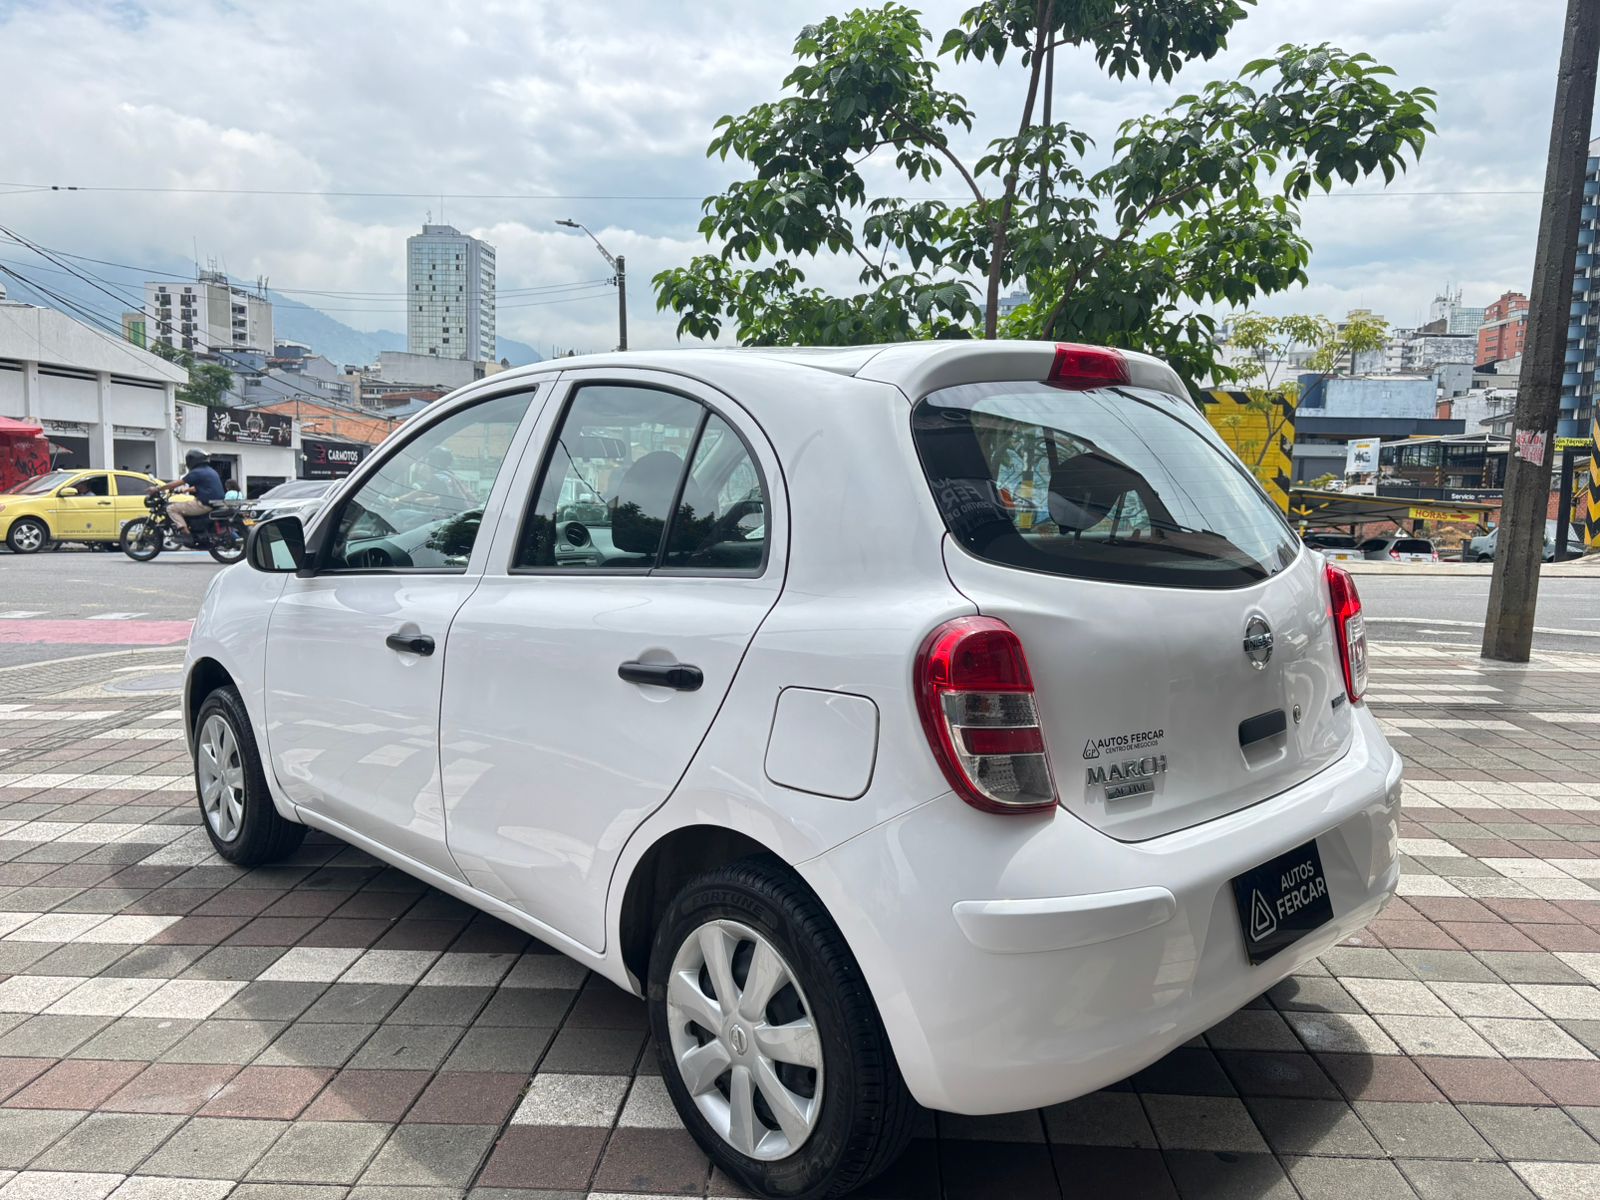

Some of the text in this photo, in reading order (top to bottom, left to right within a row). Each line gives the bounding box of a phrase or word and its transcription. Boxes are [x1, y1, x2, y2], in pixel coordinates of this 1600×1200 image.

[328, 450, 358, 461] CARMOTOS
[1415, 509, 1448, 520] HORAS
[1098, 729, 1164, 748] AUTOS FERCAR
[1105, 745, 1127, 754] CENTRO
[1134, 740, 1158, 749] NEGOCIOS
[1087, 755, 1168, 786] MARCH
[1281, 860, 1314, 892] AUTOS
[693, 891, 765, 916] FORTUNE
[1276, 877, 1326, 920] FERCAR
